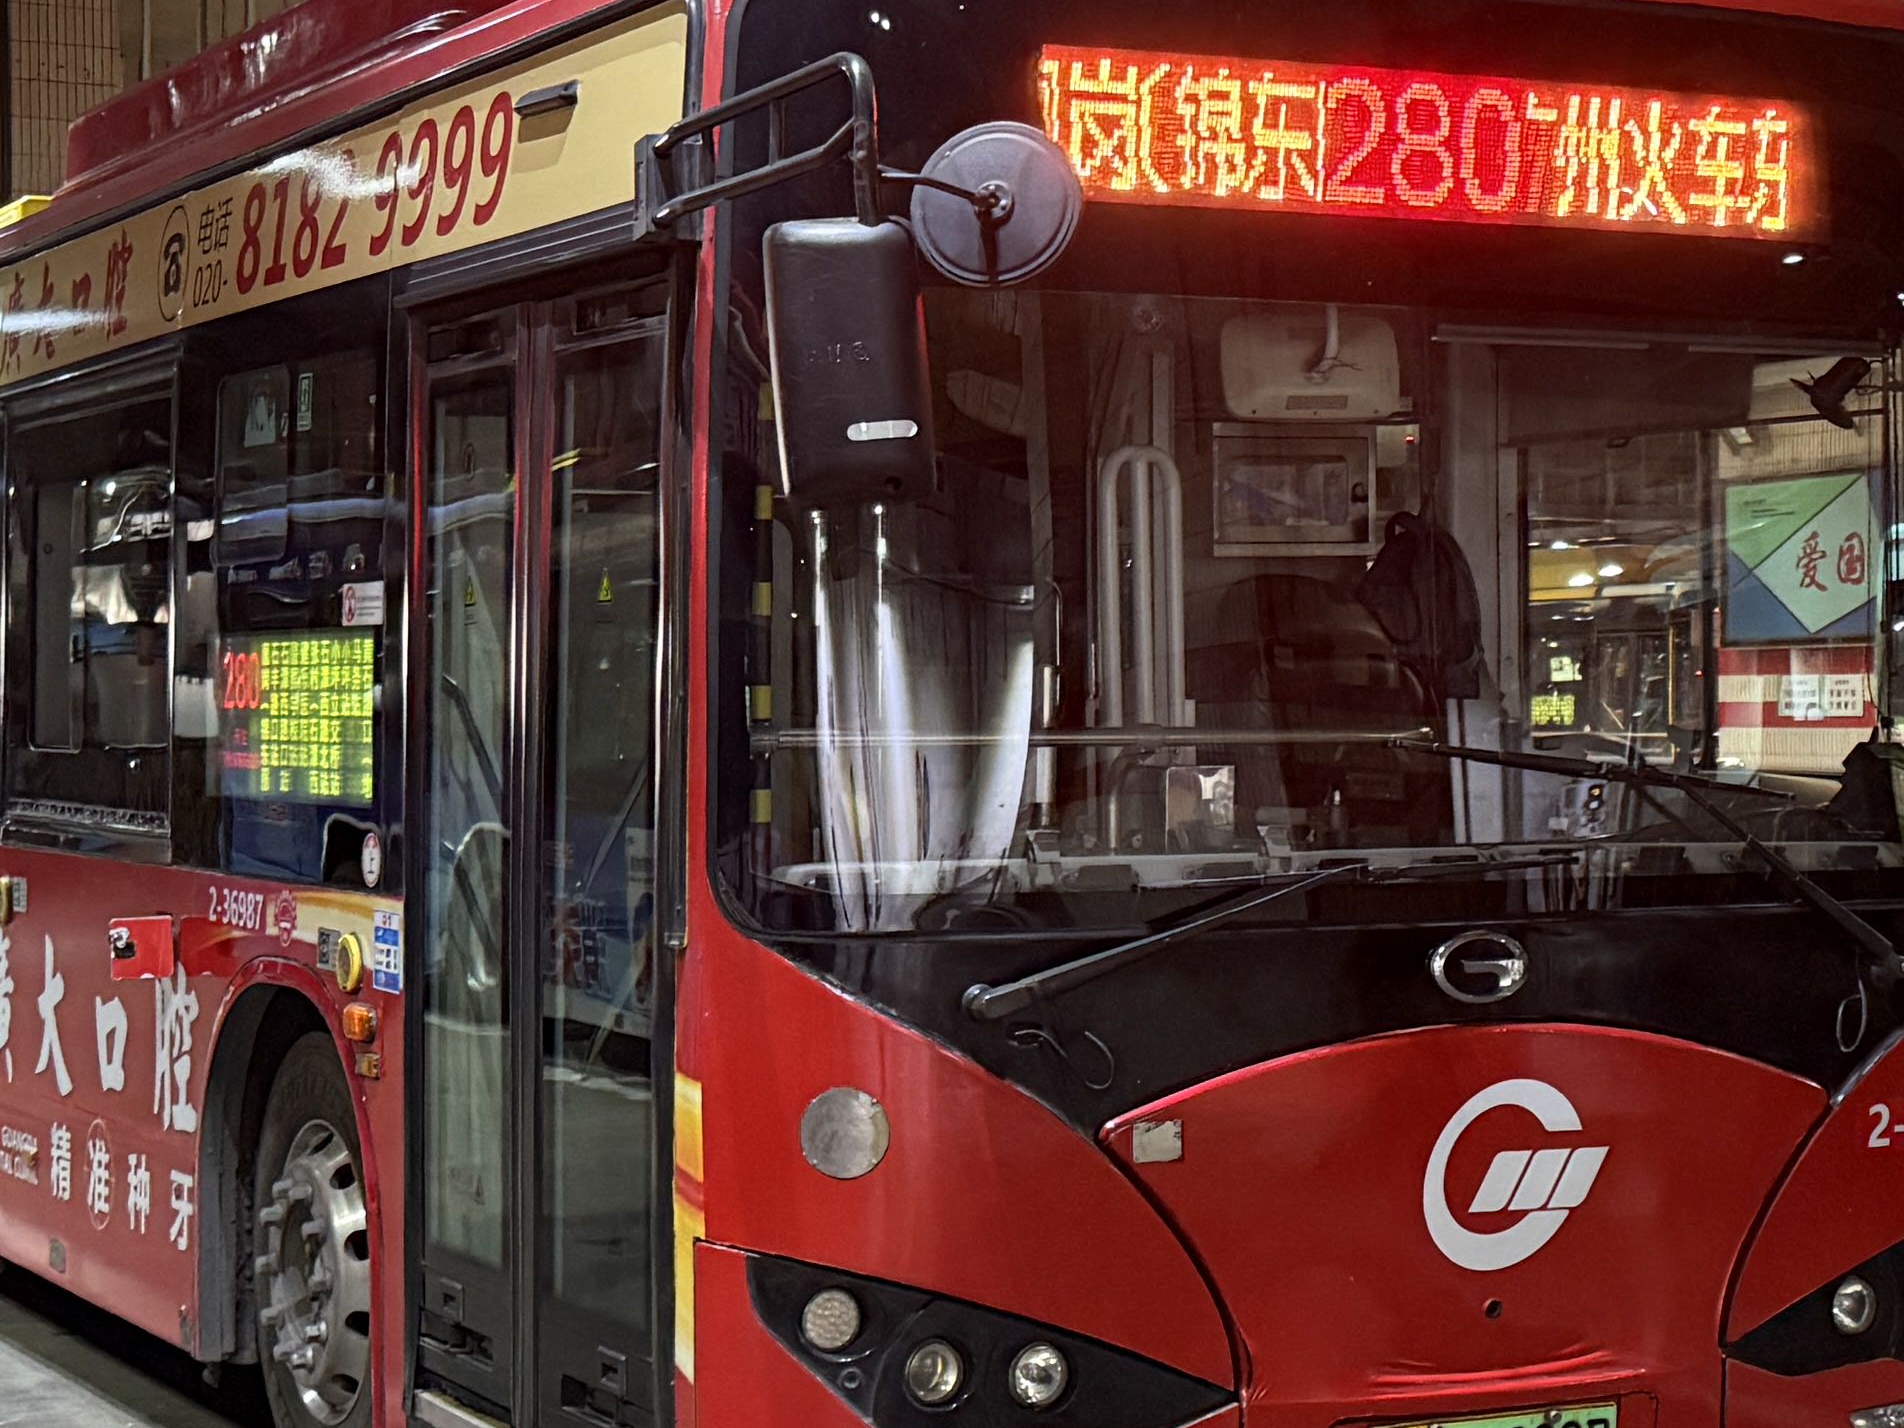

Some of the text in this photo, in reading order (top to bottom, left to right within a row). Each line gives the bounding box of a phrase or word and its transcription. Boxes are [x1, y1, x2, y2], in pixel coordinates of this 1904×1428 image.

[368, 91, 513, 256] 9999
[1325, 76, 1522, 213] 280
[197, 197, 233, 255] 电话
[1797, 530, 1865, 592] 爱国
[224, 651, 261, 709] 280
[51, 1121, 193, 1252] 精准种牙
